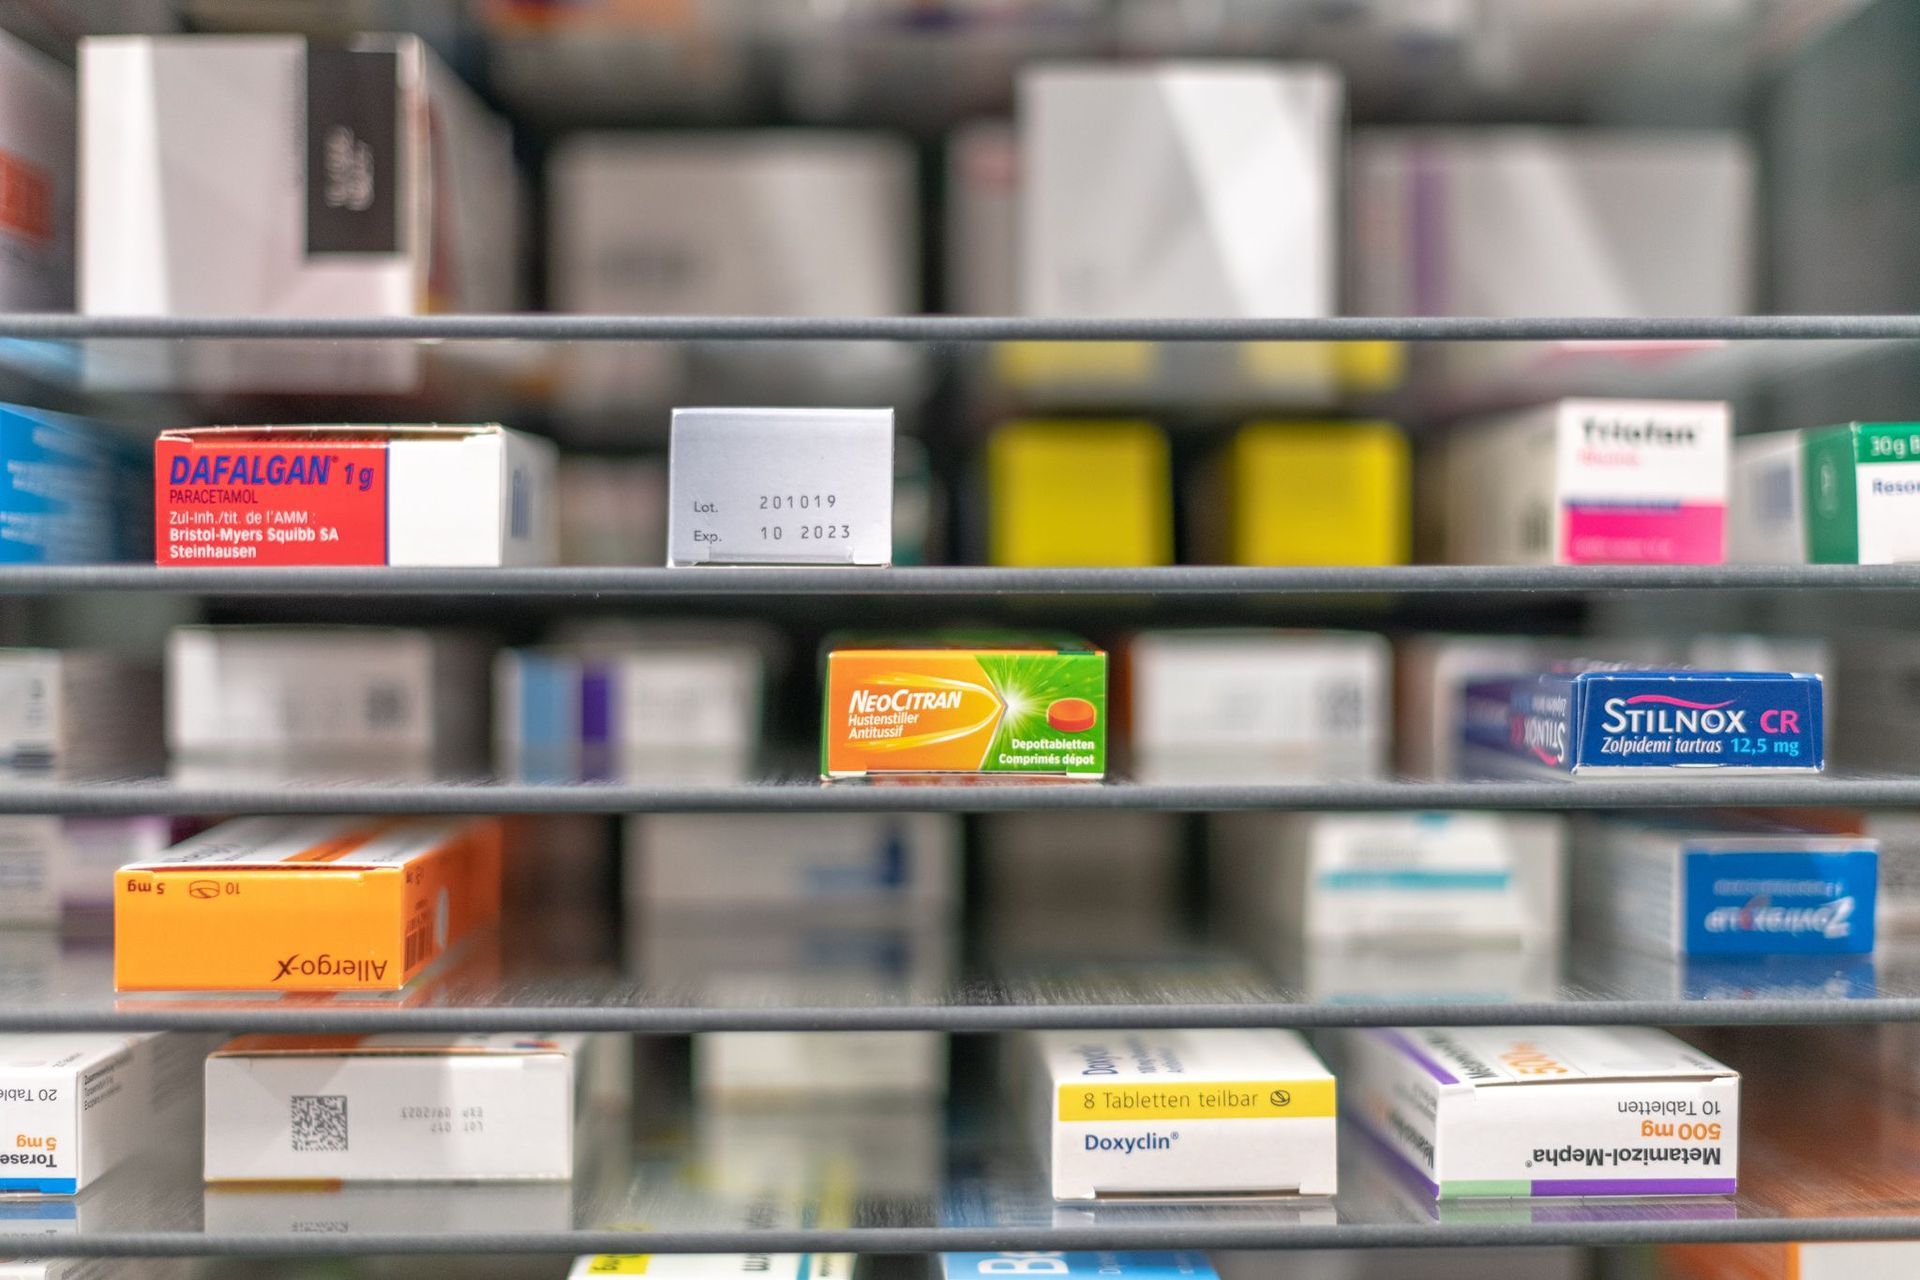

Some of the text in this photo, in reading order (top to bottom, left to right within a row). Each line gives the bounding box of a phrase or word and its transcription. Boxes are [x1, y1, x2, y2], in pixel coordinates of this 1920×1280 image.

[345, 463, 354, 485] 1
[359, 467, 374, 491] g
[169, 489, 259, 504] PARACETAMOL
[760, 494, 837, 510] 201019
[693, 501, 719, 513] Lot.
[246, 511, 262, 524] de
[169, 527, 340, 545] Bristol-Myers Squibb SA
[693, 530, 723, 545] Exp.
[760, 525, 851, 540] 10 2023
[169, 545, 258, 560] Steinhausen
[848, 711, 919, 727] Hustenstiller
[1601, 697, 1800, 734] STILNOX CR
[848, 725, 904, 739] Antitussif
[1011, 738, 1095, 752] Depottabletten
[1601, 736, 1799, 757] Zolpidemi tartras 12,5 mg
[999, 752, 1094, 767] Comprimés dépot
[127, 879, 166, 895] 5 mg
[225, 882, 241, 895] 10
[38, 1089, 57, 1101] 20
[1083, 1090, 1258, 1109] 8 Tabletten teilbar
[1617, 1100, 1721, 1116] 10 Tabletten
[1640, 1119, 1721, 1141] 500 mg
[16, 1134, 57, 1151] 5 mg
